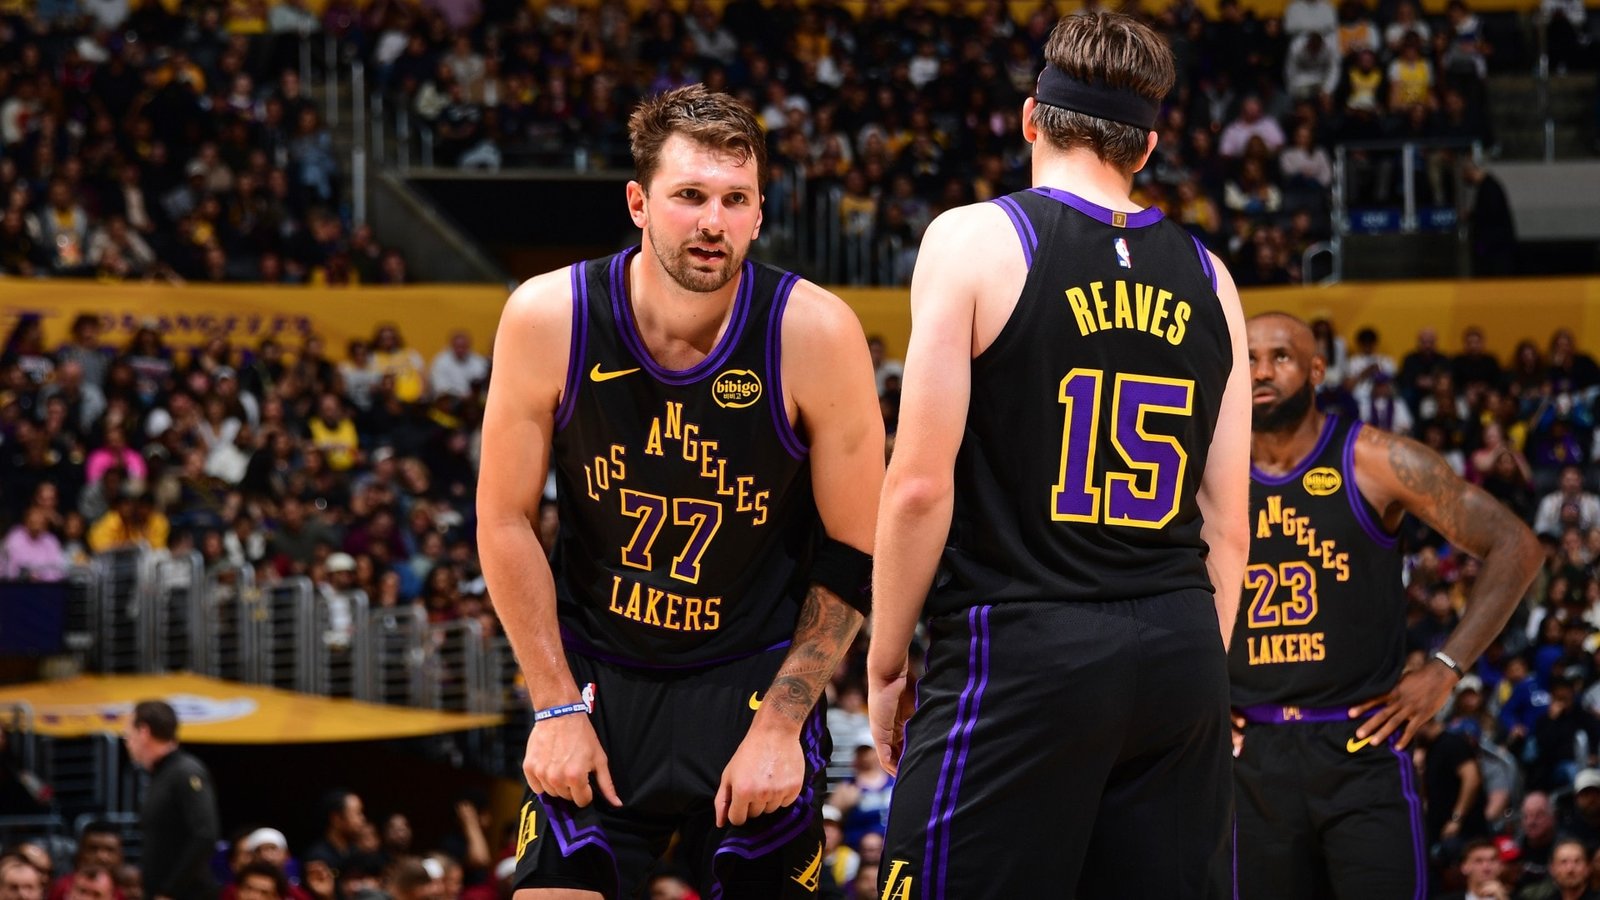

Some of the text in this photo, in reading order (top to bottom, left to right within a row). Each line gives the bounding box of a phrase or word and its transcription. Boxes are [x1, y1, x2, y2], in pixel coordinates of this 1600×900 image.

[1065, 280, 1192, 346] REAVES
[716, 379, 759, 397] bibigo
[584, 400, 770, 526] LOS ANGELES
[1050, 367, 1196, 530] 15
[619, 488, 723, 585] 77
[1256, 494, 1350, 582] ANGELES
[609, 575, 722, 631] LAKERS
[1244, 560, 1319, 629] 23
[1247, 632, 1326, 666] LAKERS
